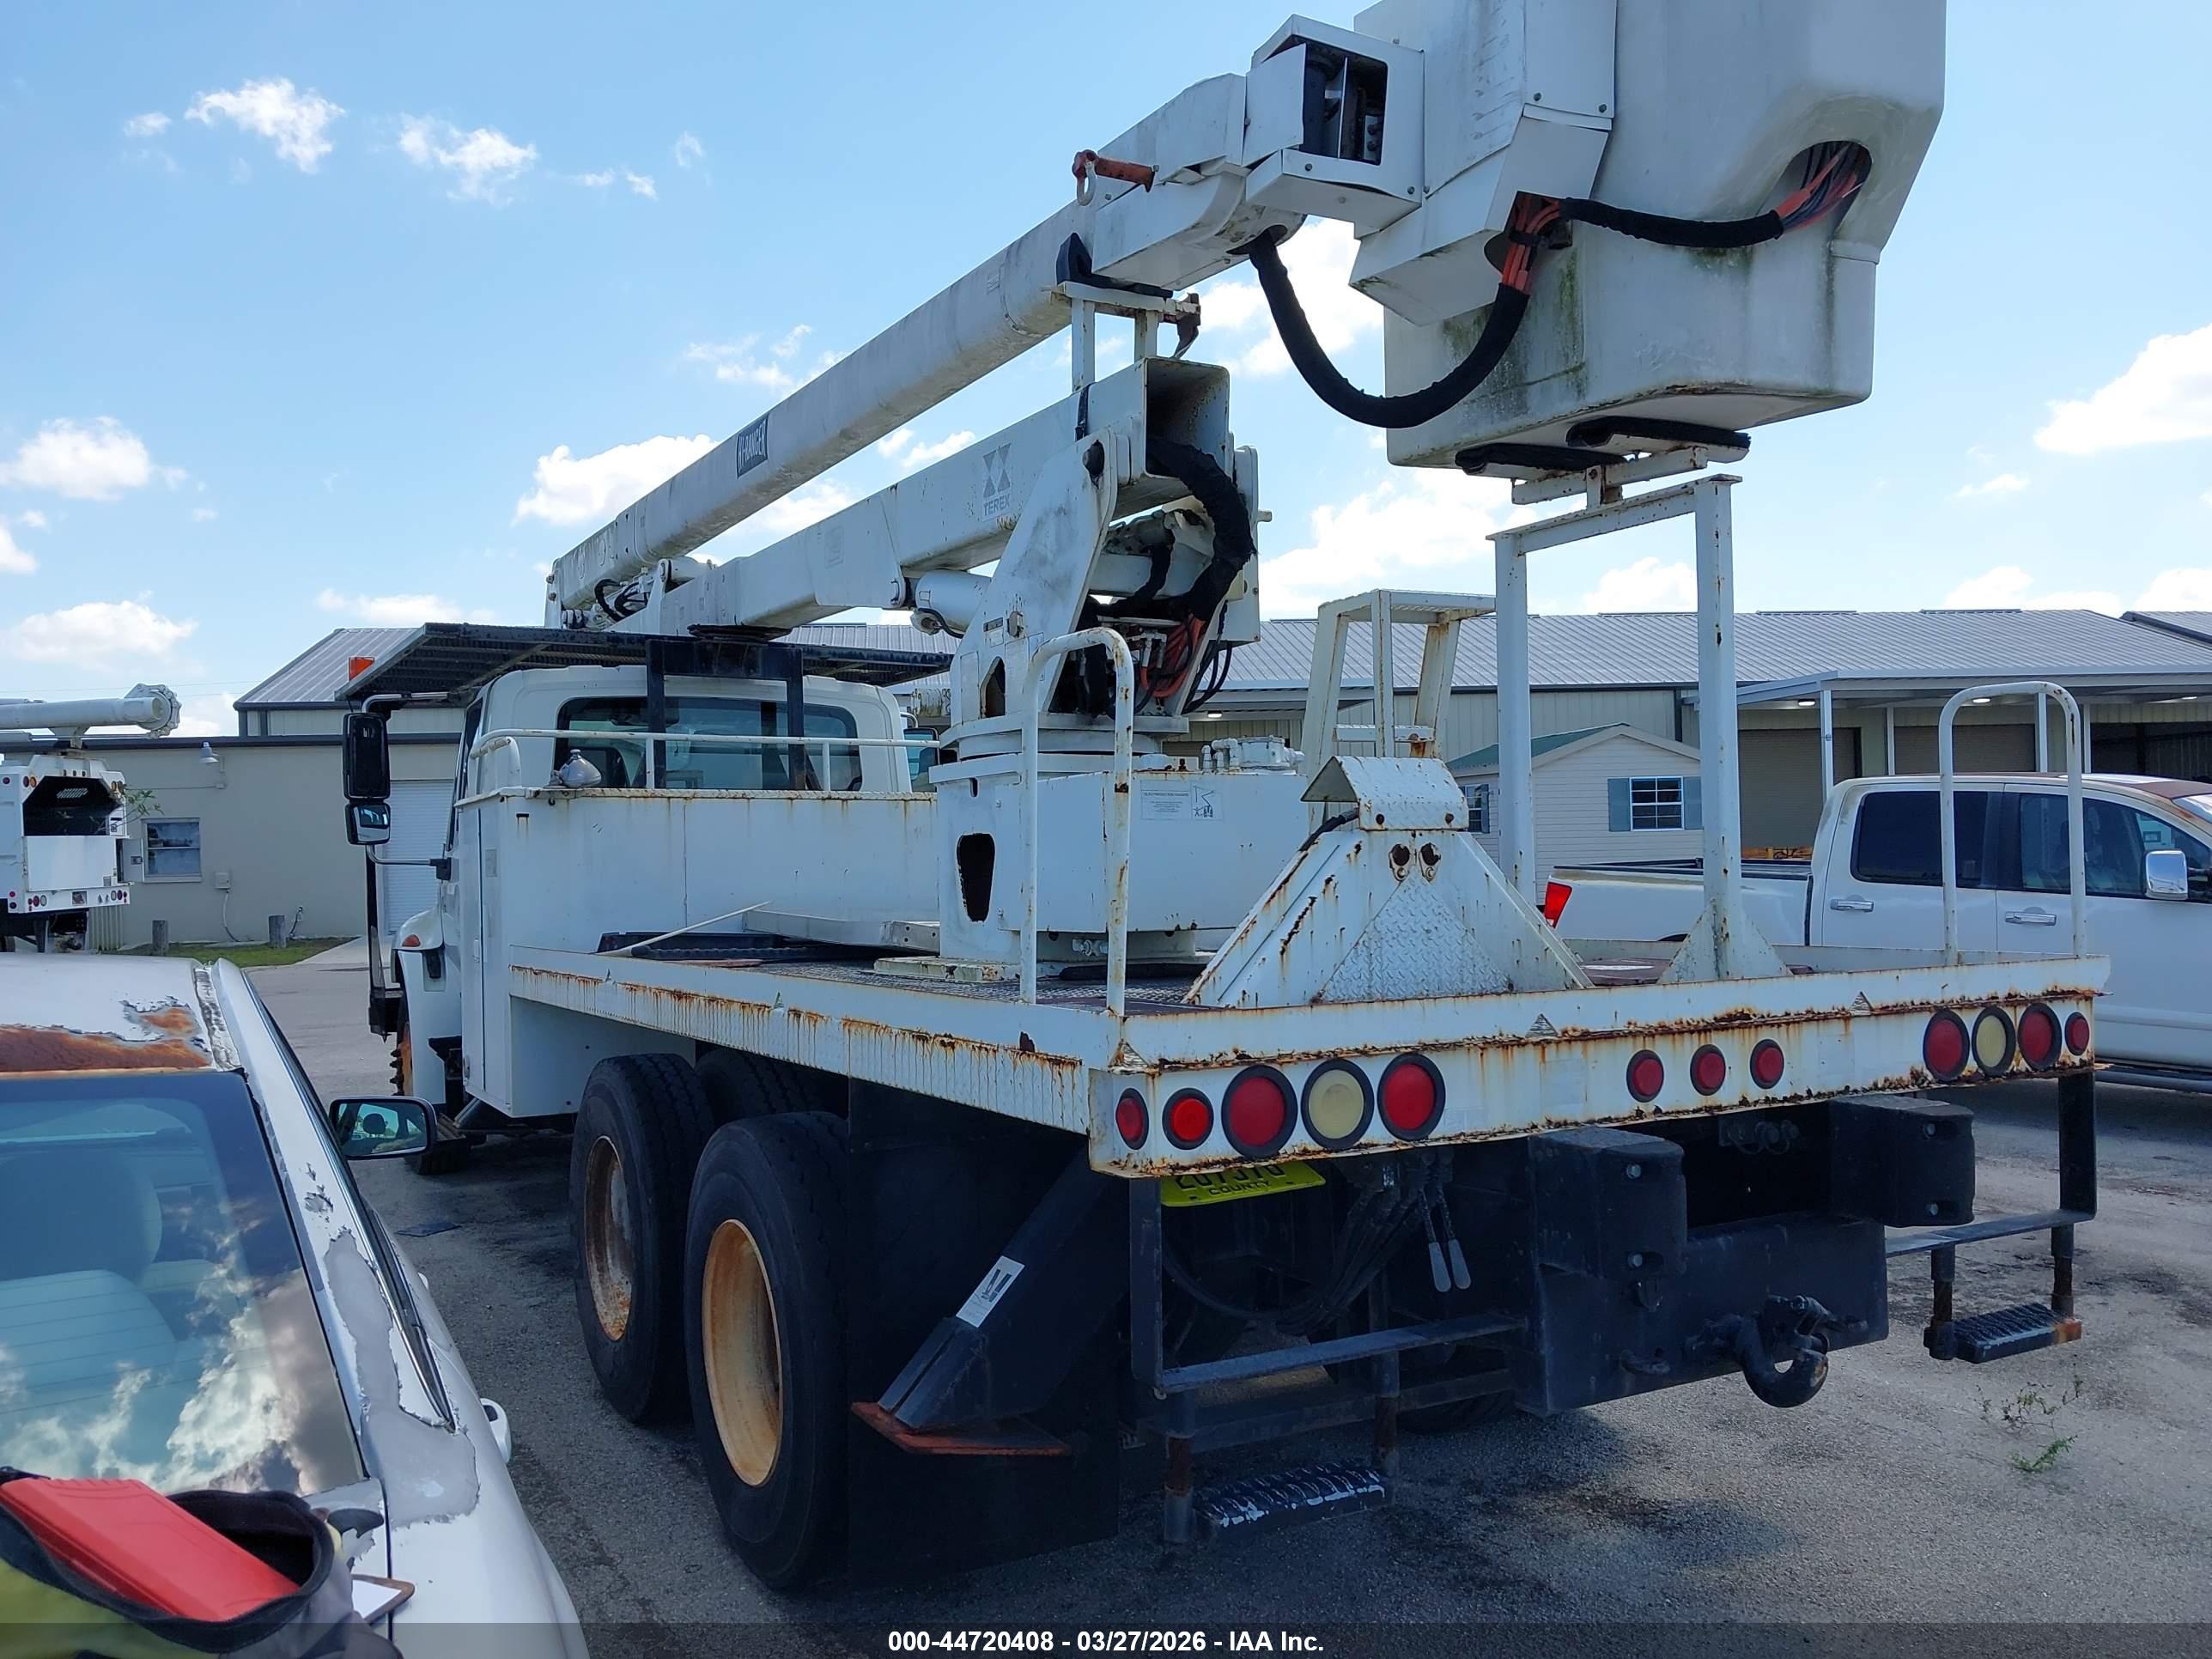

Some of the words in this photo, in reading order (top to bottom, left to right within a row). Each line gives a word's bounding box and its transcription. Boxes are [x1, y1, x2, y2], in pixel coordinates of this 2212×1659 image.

[738, 418, 767, 473] HI-RANGER
[983, 493, 1011, 516] TEREX
[1208, 1181, 1270, 1195] COUNTY
